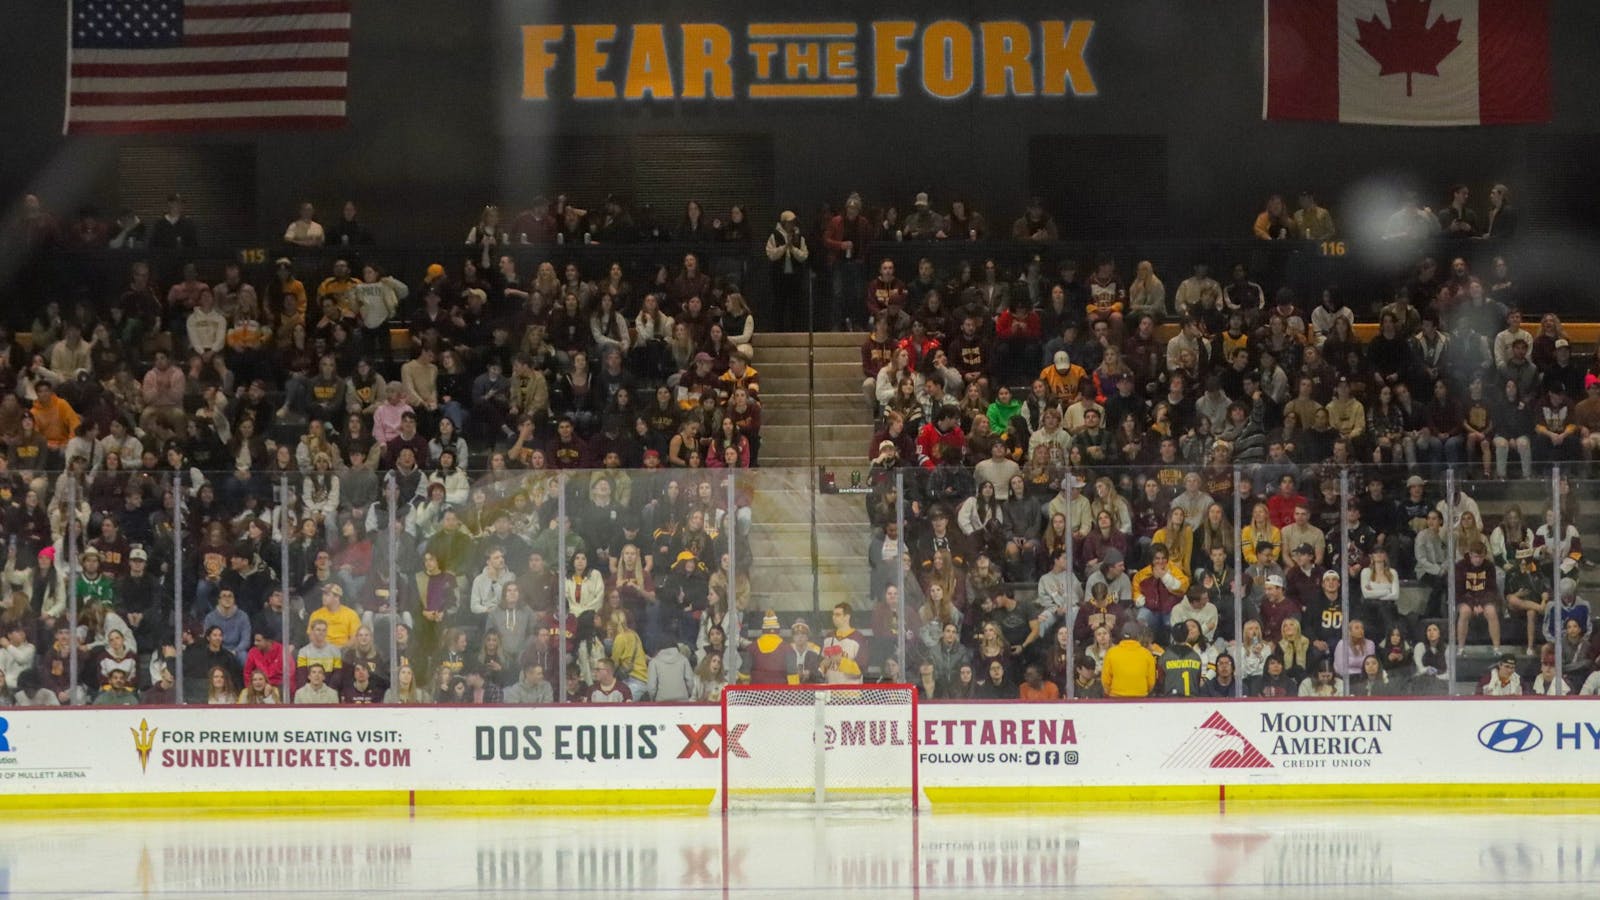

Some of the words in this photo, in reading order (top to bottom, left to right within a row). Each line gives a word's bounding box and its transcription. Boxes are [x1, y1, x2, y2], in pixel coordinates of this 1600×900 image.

[521, 23, 735, 99] FEAR
[749, 42, 858, 79] THE
[871, 19, 1097, 99] FORK
[241, 249, 265, 264] 115
[1320, 241, 1345, 256] 116
[1321, 610, 1343, 629] 90
[1182, 671, 1190, 696] 1
[1260, 712, 1392, 733] MOUNTAIN
[162, 731, 194, 743] FOR
[200, 730, 279, 743] PREMIUM
[283, 730, 353, 743] SEATING
[356, 730, 402, 743] VISIT:
[476, 725, 542, 761] DOS
[1271, 734, 1382, 755] AMERICA
[162, 748, 411, 768] SUNDEVILTICKETS.COM
[920, 753, 974, 764] FOLLOW
[977, 753, 996, 764] US
[999, 753, 1022, 764] ON:
[1283, 759, 1327, 768] CREDIT
[1332, 759, 1371, 768] UNION
[4, 771, 16, 780] OF
[18, 771, 55, 779] MULLETT
[57, 771, 87, 779] ARENA
